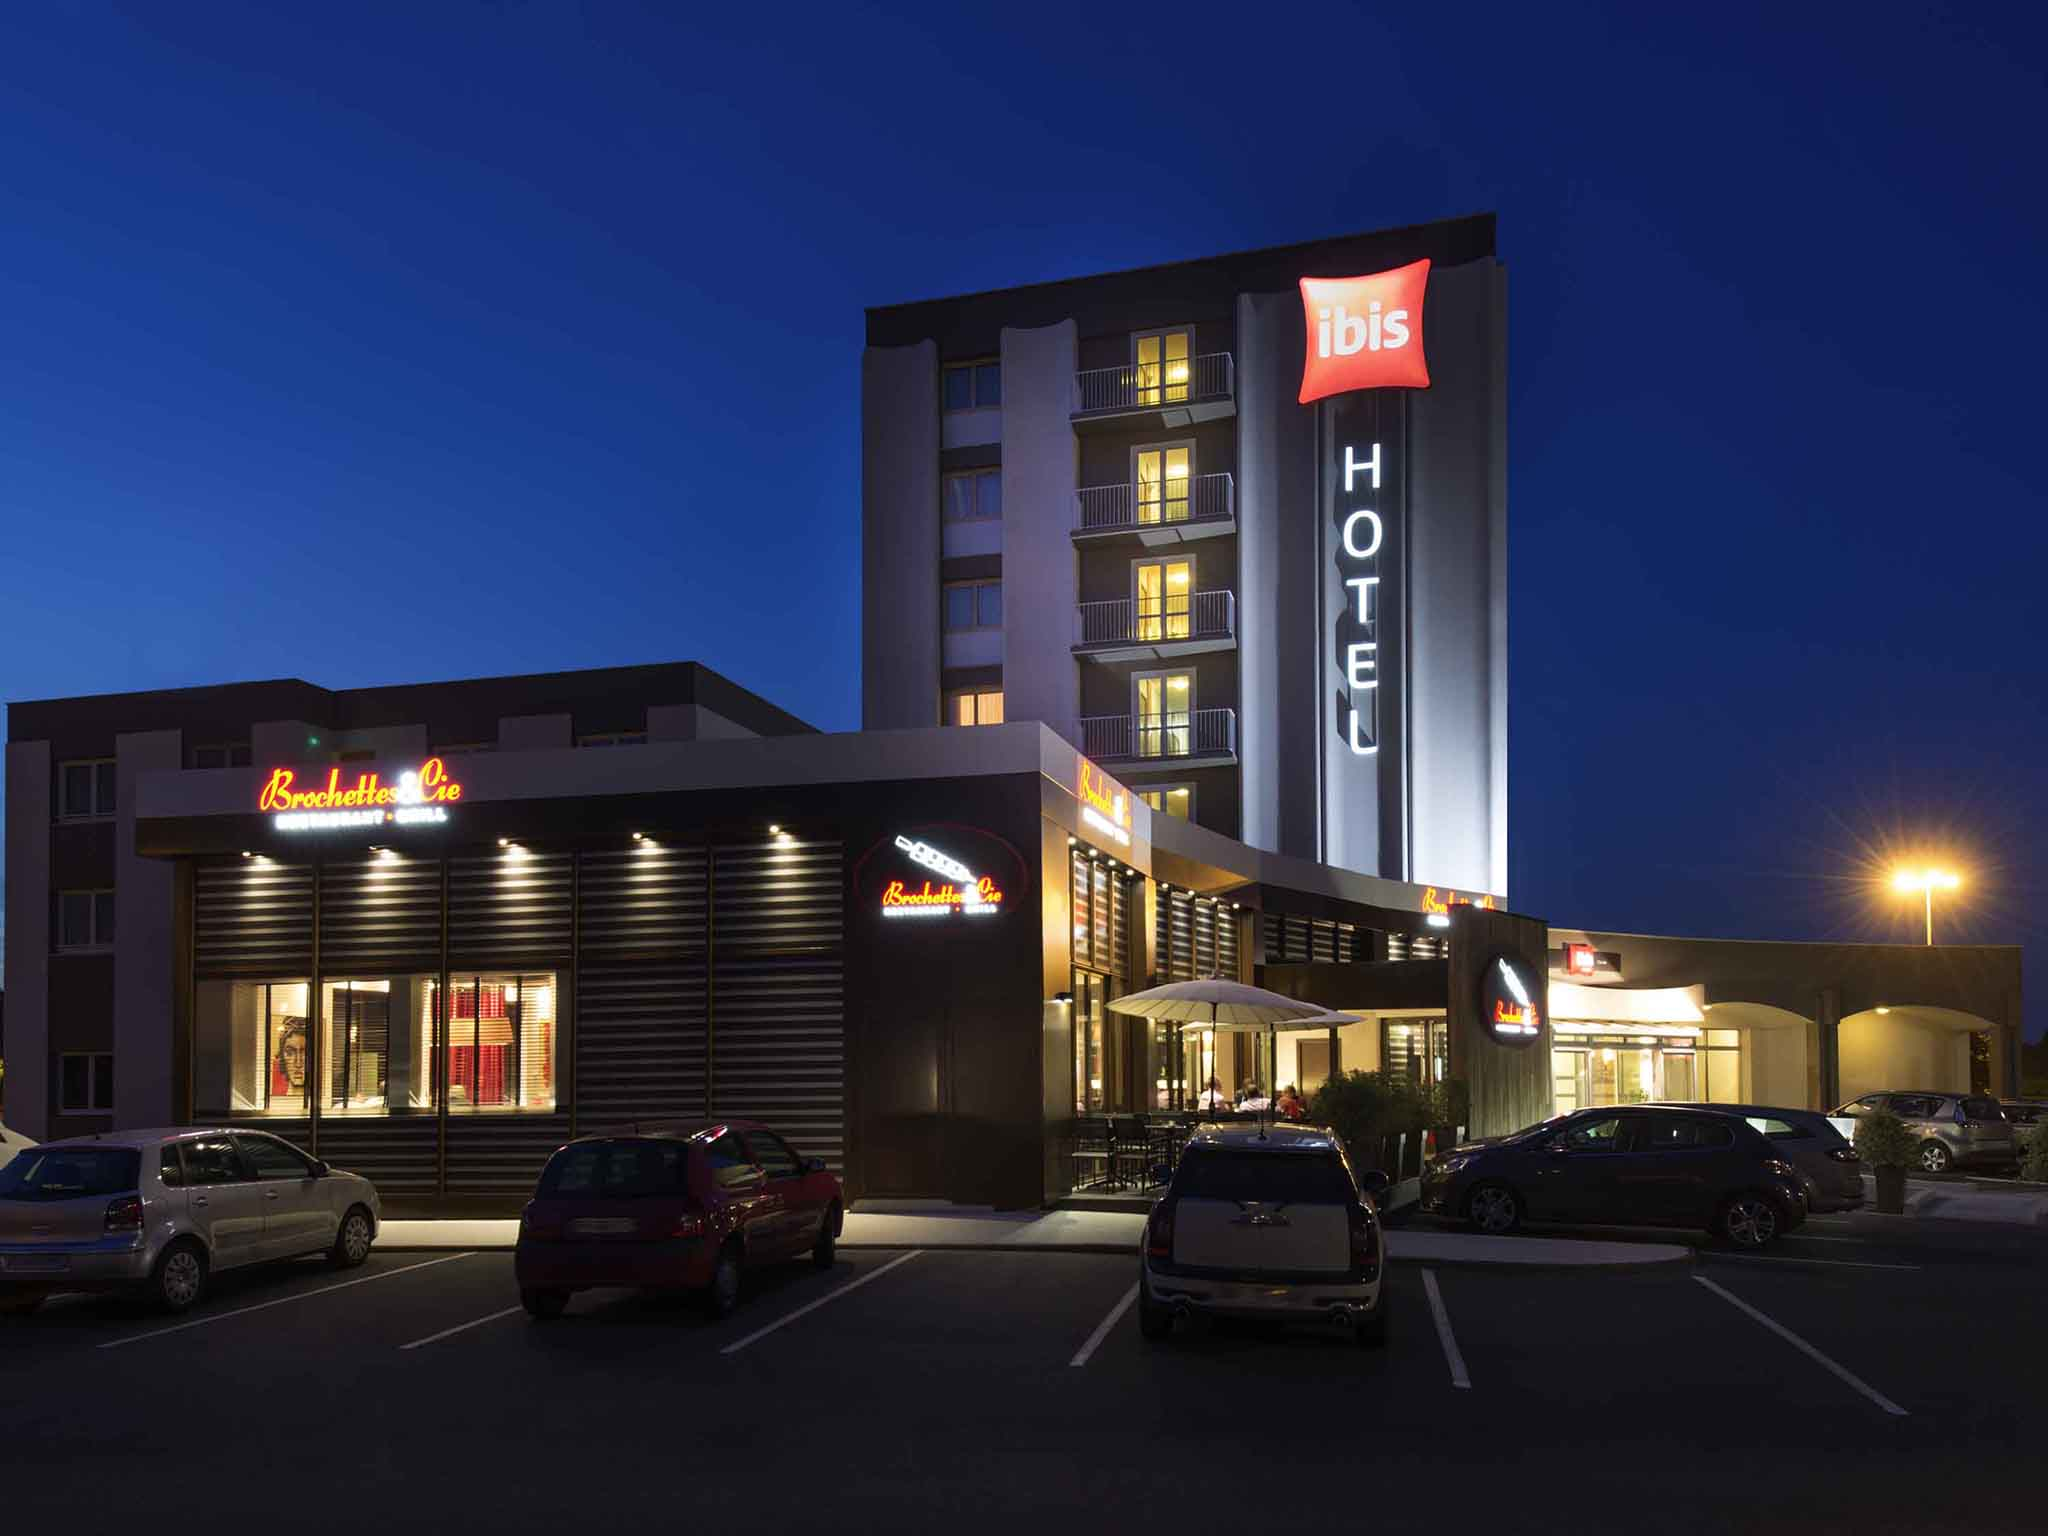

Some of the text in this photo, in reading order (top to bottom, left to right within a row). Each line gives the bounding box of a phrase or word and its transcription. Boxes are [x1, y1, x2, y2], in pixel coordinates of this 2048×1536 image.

[1318, 301, 1410, 358] ibis
[1342, 443, 1383, 755] HOTEL
[259, 767, 399, 811] Brochettes
[417, 757, 462, 802] Cie
